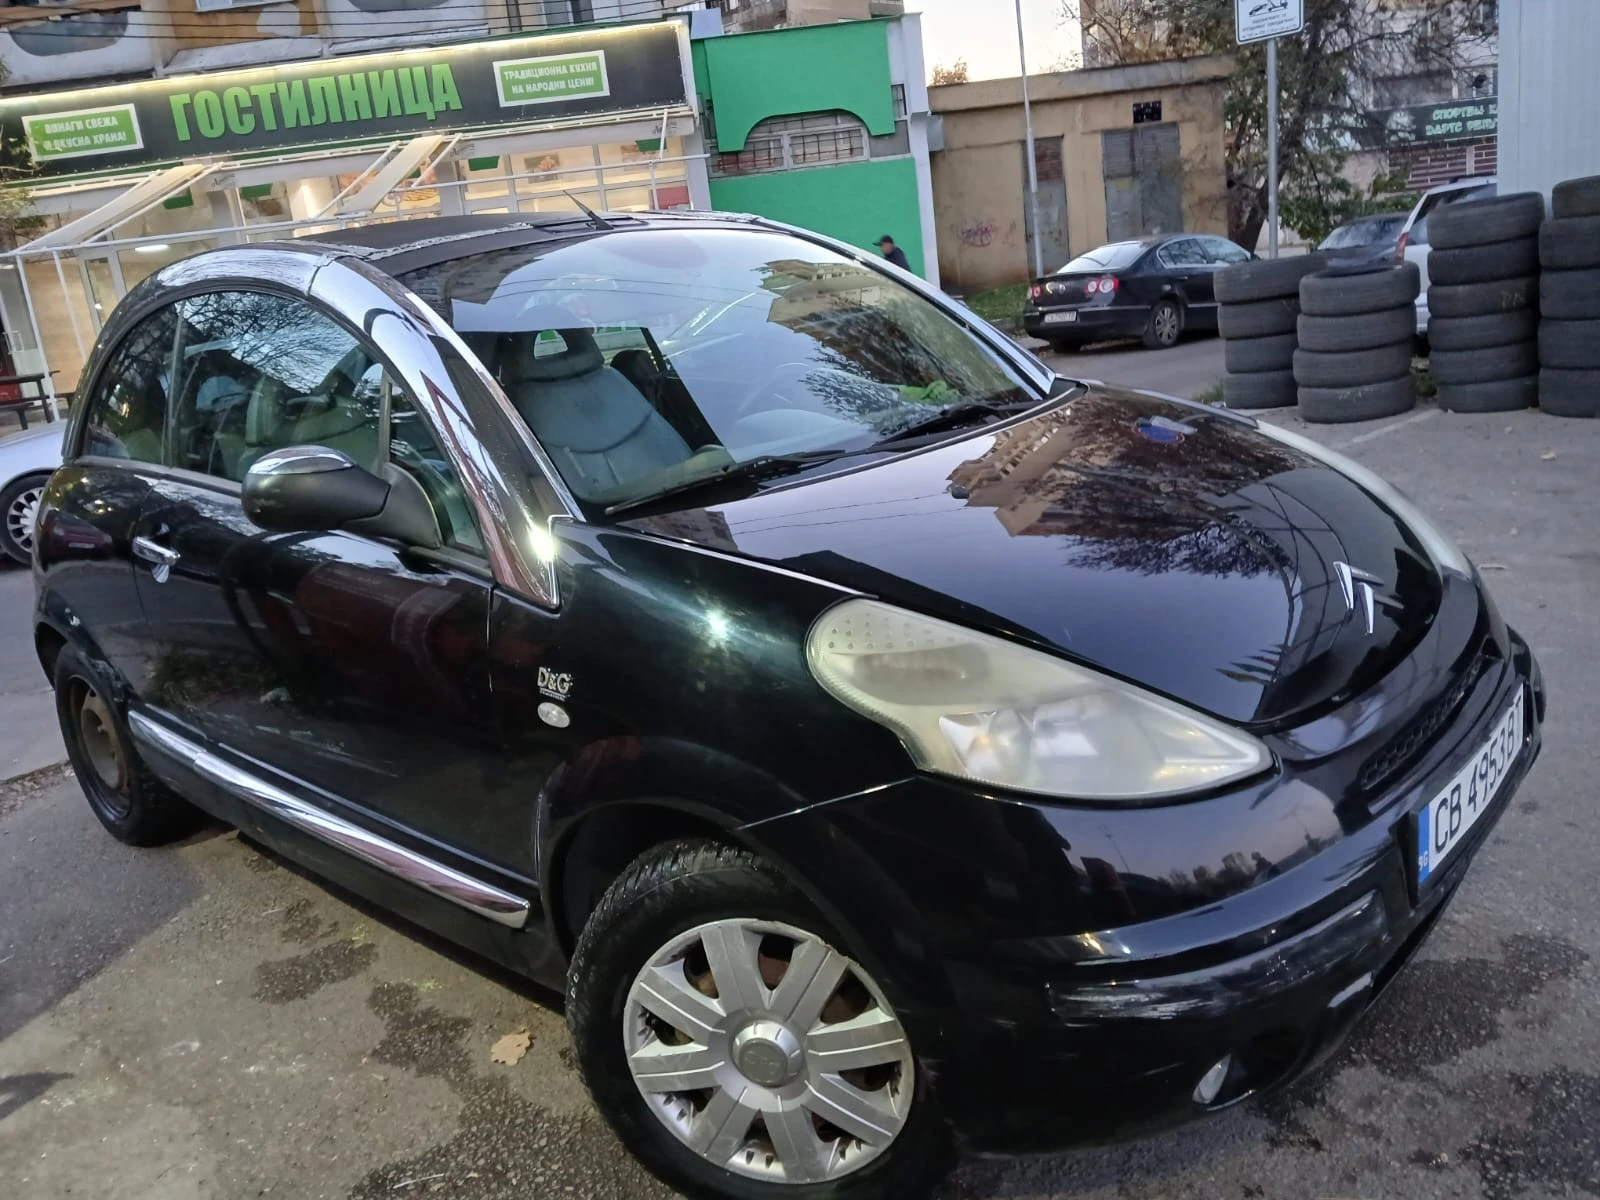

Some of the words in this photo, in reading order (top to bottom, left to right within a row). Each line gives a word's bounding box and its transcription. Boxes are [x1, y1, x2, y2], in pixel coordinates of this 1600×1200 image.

[504, 66, 567, 79] ТРАДИЦИОННА
[569, 62, 598, 73] КУХНЯ
[512, 85, 524, 94] НА
[526, 81, 566, 92] НАРОДНИ
[169, 63, 463, 141] ГОСТИЛНИЦА
[86, 117, 118, 129] СВЕЖА
